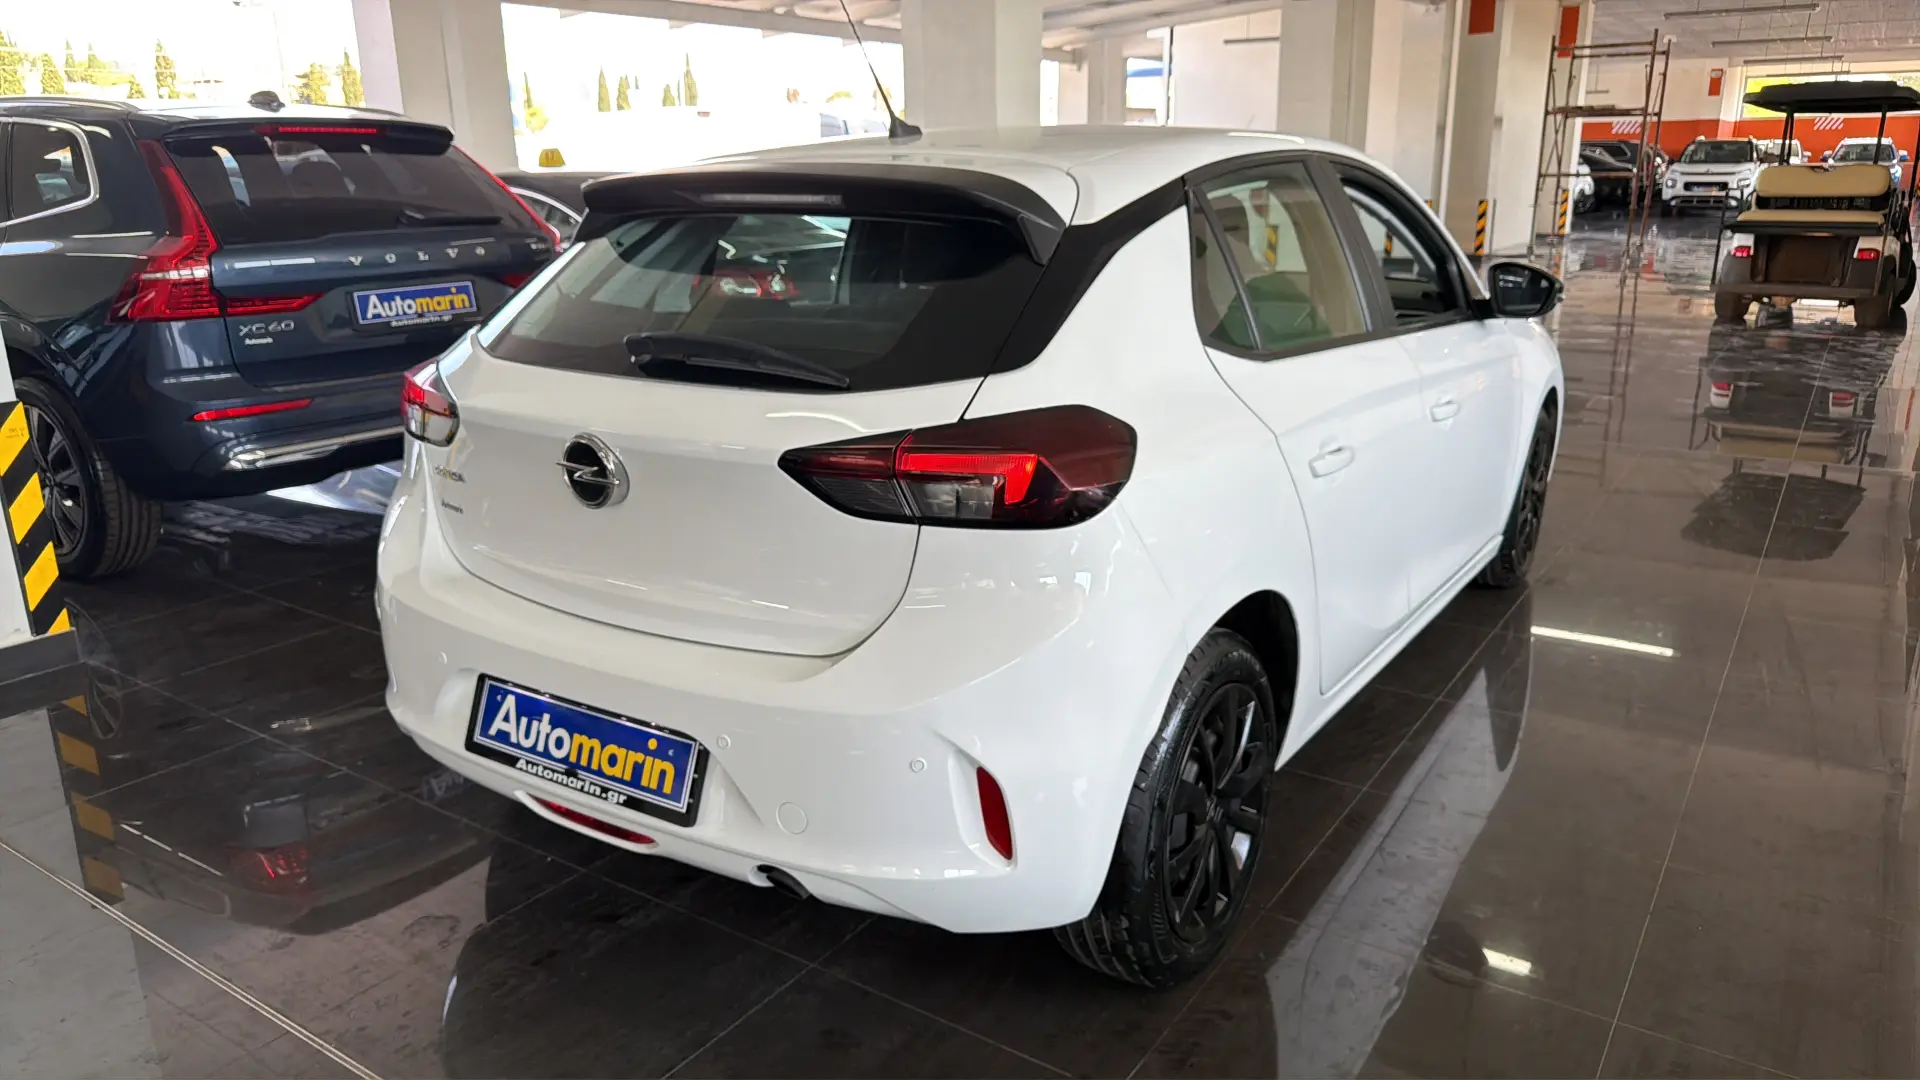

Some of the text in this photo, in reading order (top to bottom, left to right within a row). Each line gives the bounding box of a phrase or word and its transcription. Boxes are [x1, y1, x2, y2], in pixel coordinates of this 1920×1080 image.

[349, 246, 486, 266] VOLVO
[367, 287, 470, 319] Automarin
[488, 694, 676, 795] Automarin
[515, 758, 628, 804] Automarin.gr
